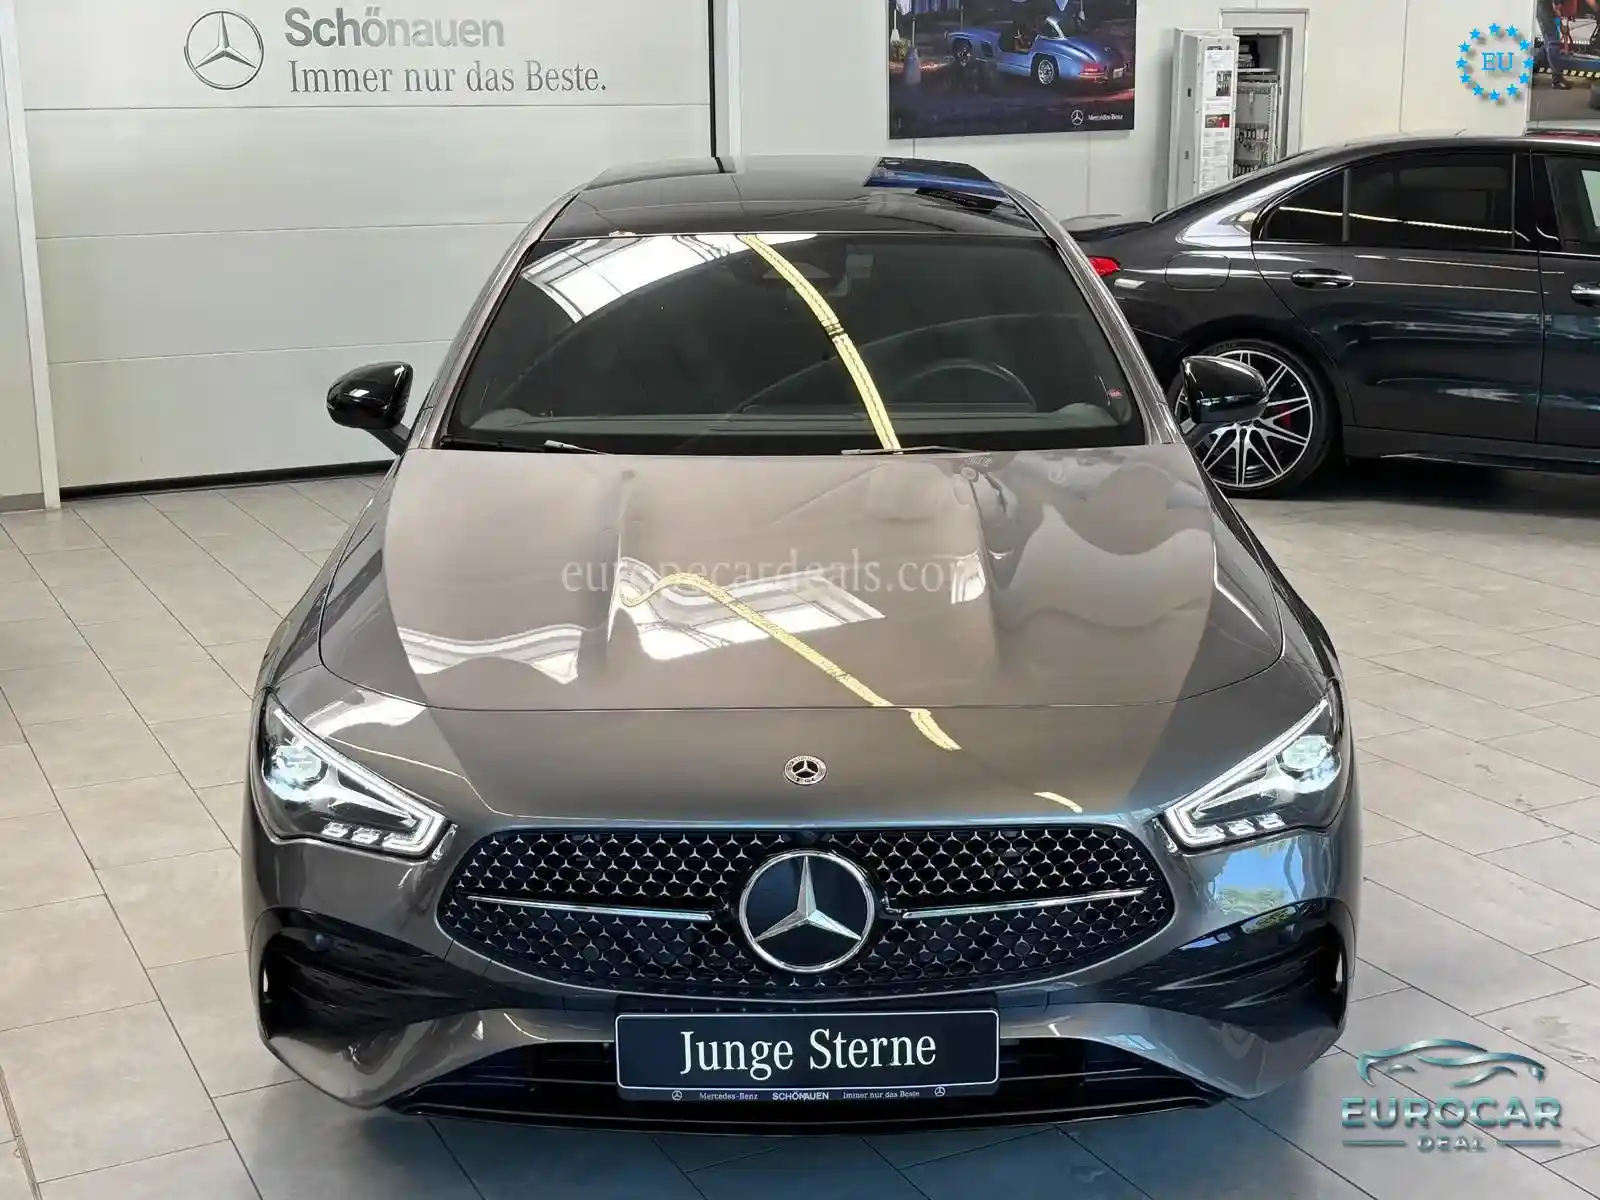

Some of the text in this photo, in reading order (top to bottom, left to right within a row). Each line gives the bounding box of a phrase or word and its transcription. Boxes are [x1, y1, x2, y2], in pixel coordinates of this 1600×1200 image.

[284, 6, 505, 47] Schönauen
[288, 59, 607, 93] Immer nur das Beste.
[680, 1028, 937, 1081] Junge Sterne
[699, 1092, 759, 1101] Mercedes-Benz
[772, 1090, 829, 1101] SCHÖNAUEN
[900, 1090, 920, 1098] Beste
